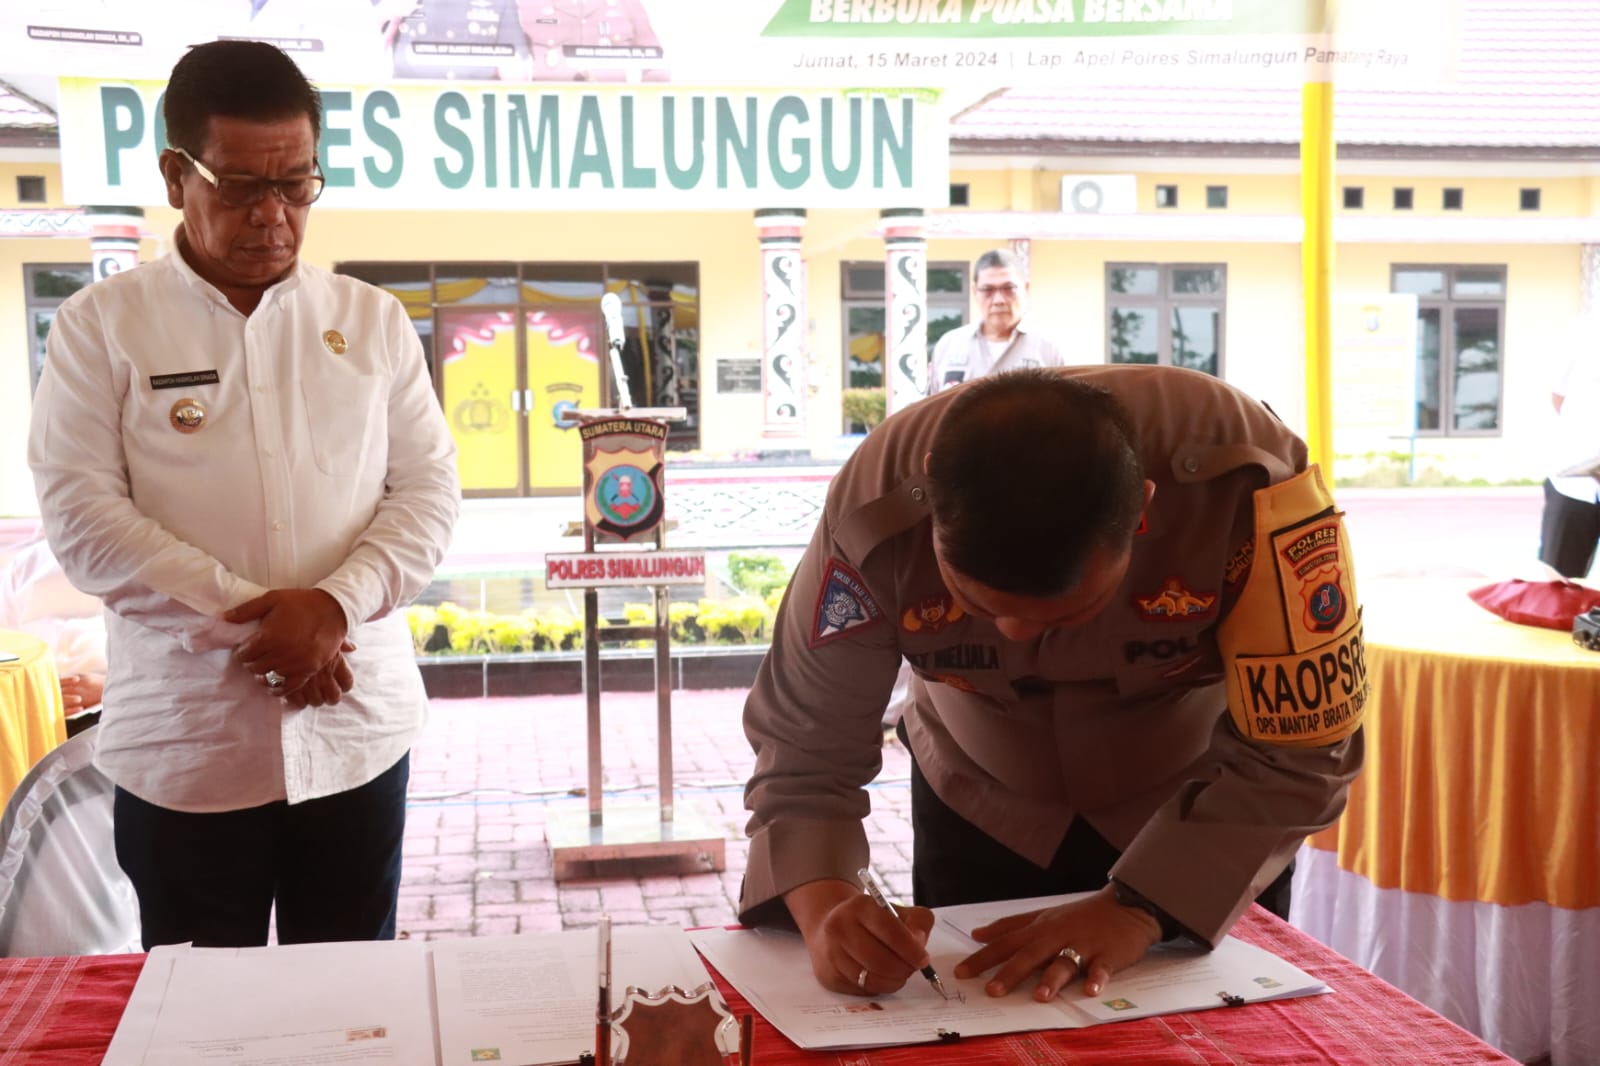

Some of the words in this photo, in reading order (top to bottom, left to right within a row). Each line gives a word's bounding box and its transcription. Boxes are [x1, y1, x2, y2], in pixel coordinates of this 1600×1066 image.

[808, 0, 964, 24] BERBUKA
[968, 0, 1075, 24] PUASA
[793, 52, 858, 69] Jumat,
[866, 53, 888, 67] 15
[894, 52, 948, 67] Maret
[954, 51, 998, 67] 2024
[1073, 50, 1116, 67] Apel
[1121, 50, 1179, 66] Polres
[1187, 49, 1297, 68] Simalungun
[1375, 49, 1409, 69] Raya
[100, 86, 404, 189] PES
[433, 91, 913, 190] SIMALUNGUN
[582, 420, 633, 439] SUMATERA
[633, 421, 665, 438] UTARA
[1287, 527, 1336, 558] POLRES
[549, 559, 605, 580] POLRES
[607, 556, 705, 578] SIMALUNGUN
[1256, 716, 1277, 735] OPS
[1279, 711, 1320, 736] MANTAP
[1323, 702, 1351, 729] BRATA
